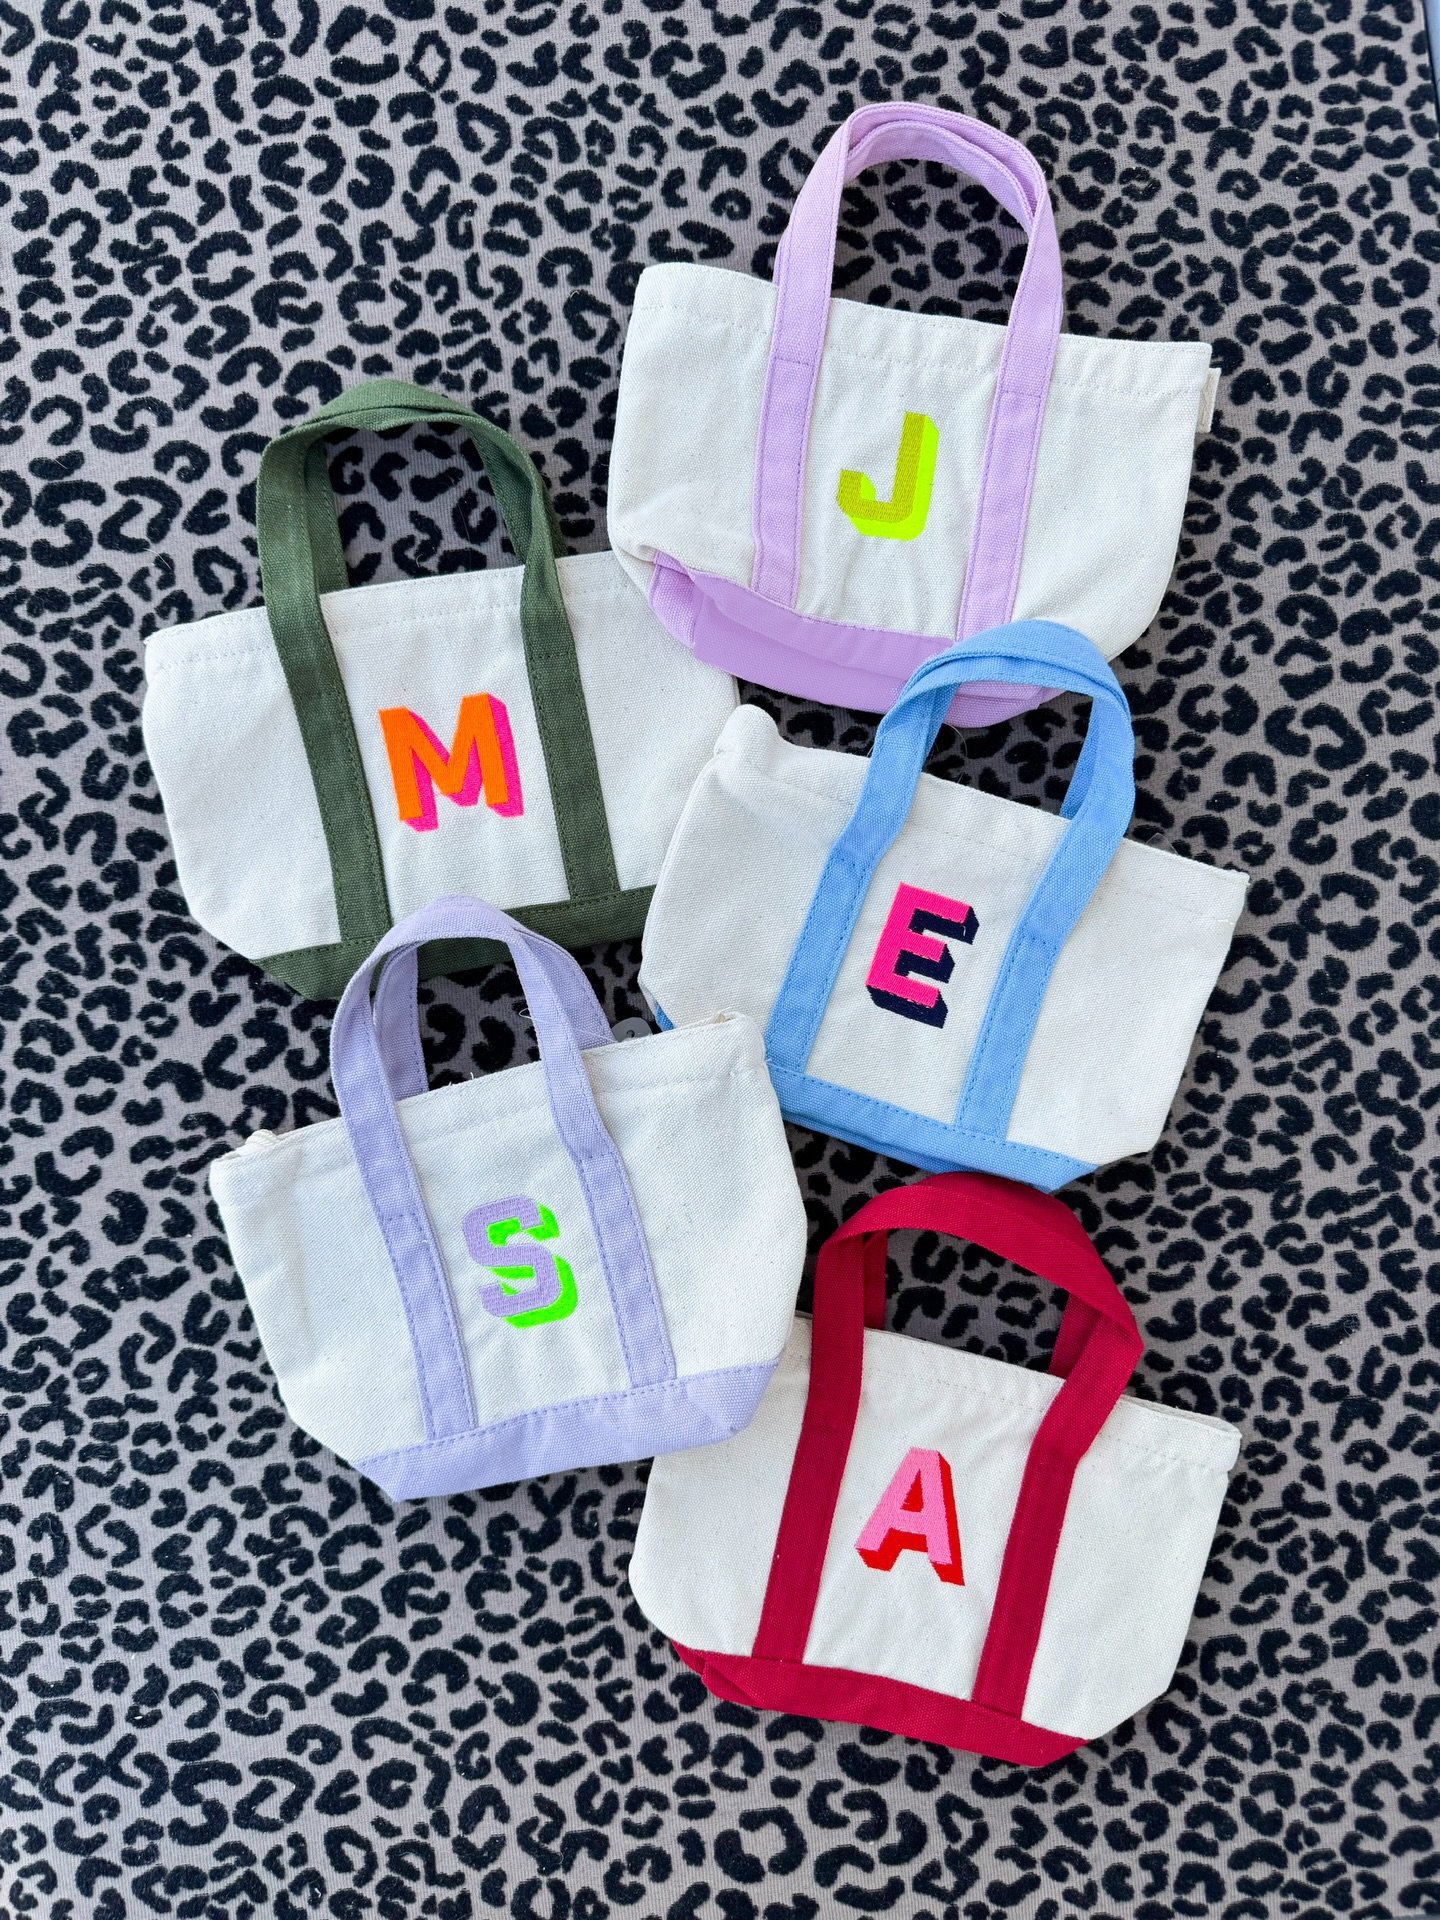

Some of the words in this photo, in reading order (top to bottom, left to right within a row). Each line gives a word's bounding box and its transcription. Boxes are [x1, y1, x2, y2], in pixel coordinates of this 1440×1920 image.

[836, 411, 940, 542] J
[378, 692, 524, 832] M
[865, 882, 979, 1028] E
[461, 1194, 579, 1331] S
[855, 1448, 965, 1586] A
